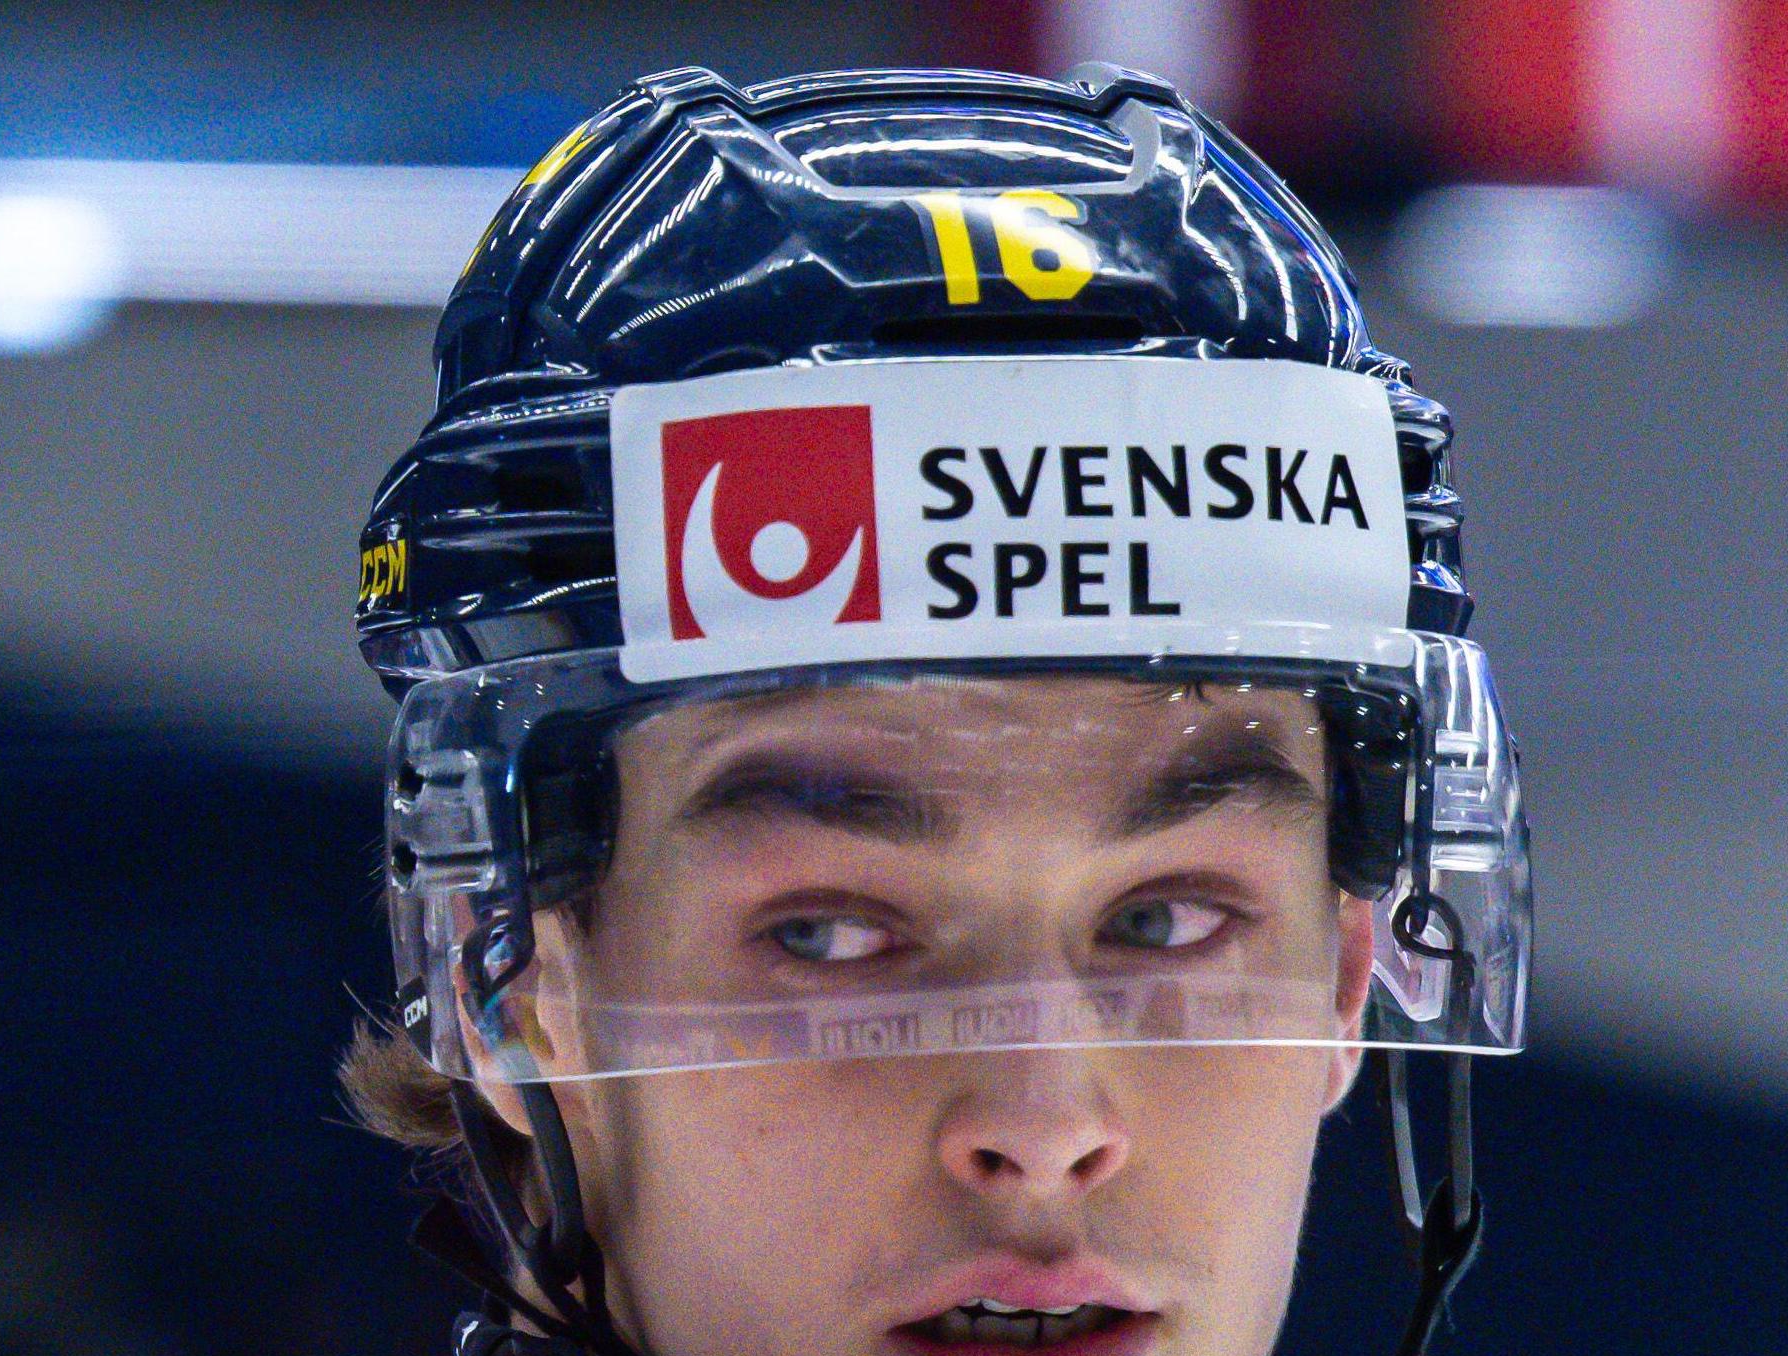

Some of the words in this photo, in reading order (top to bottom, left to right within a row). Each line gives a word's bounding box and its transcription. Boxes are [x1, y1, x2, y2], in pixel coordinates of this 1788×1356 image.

[916, 189, 1094, 305] 16
[919, 443, 1371, 531] SVENSKA
[359, 538, 406, 602] CCM
[925, 541, 1183, 620] SPEL
[404, 995, 427, 1028] CCM
